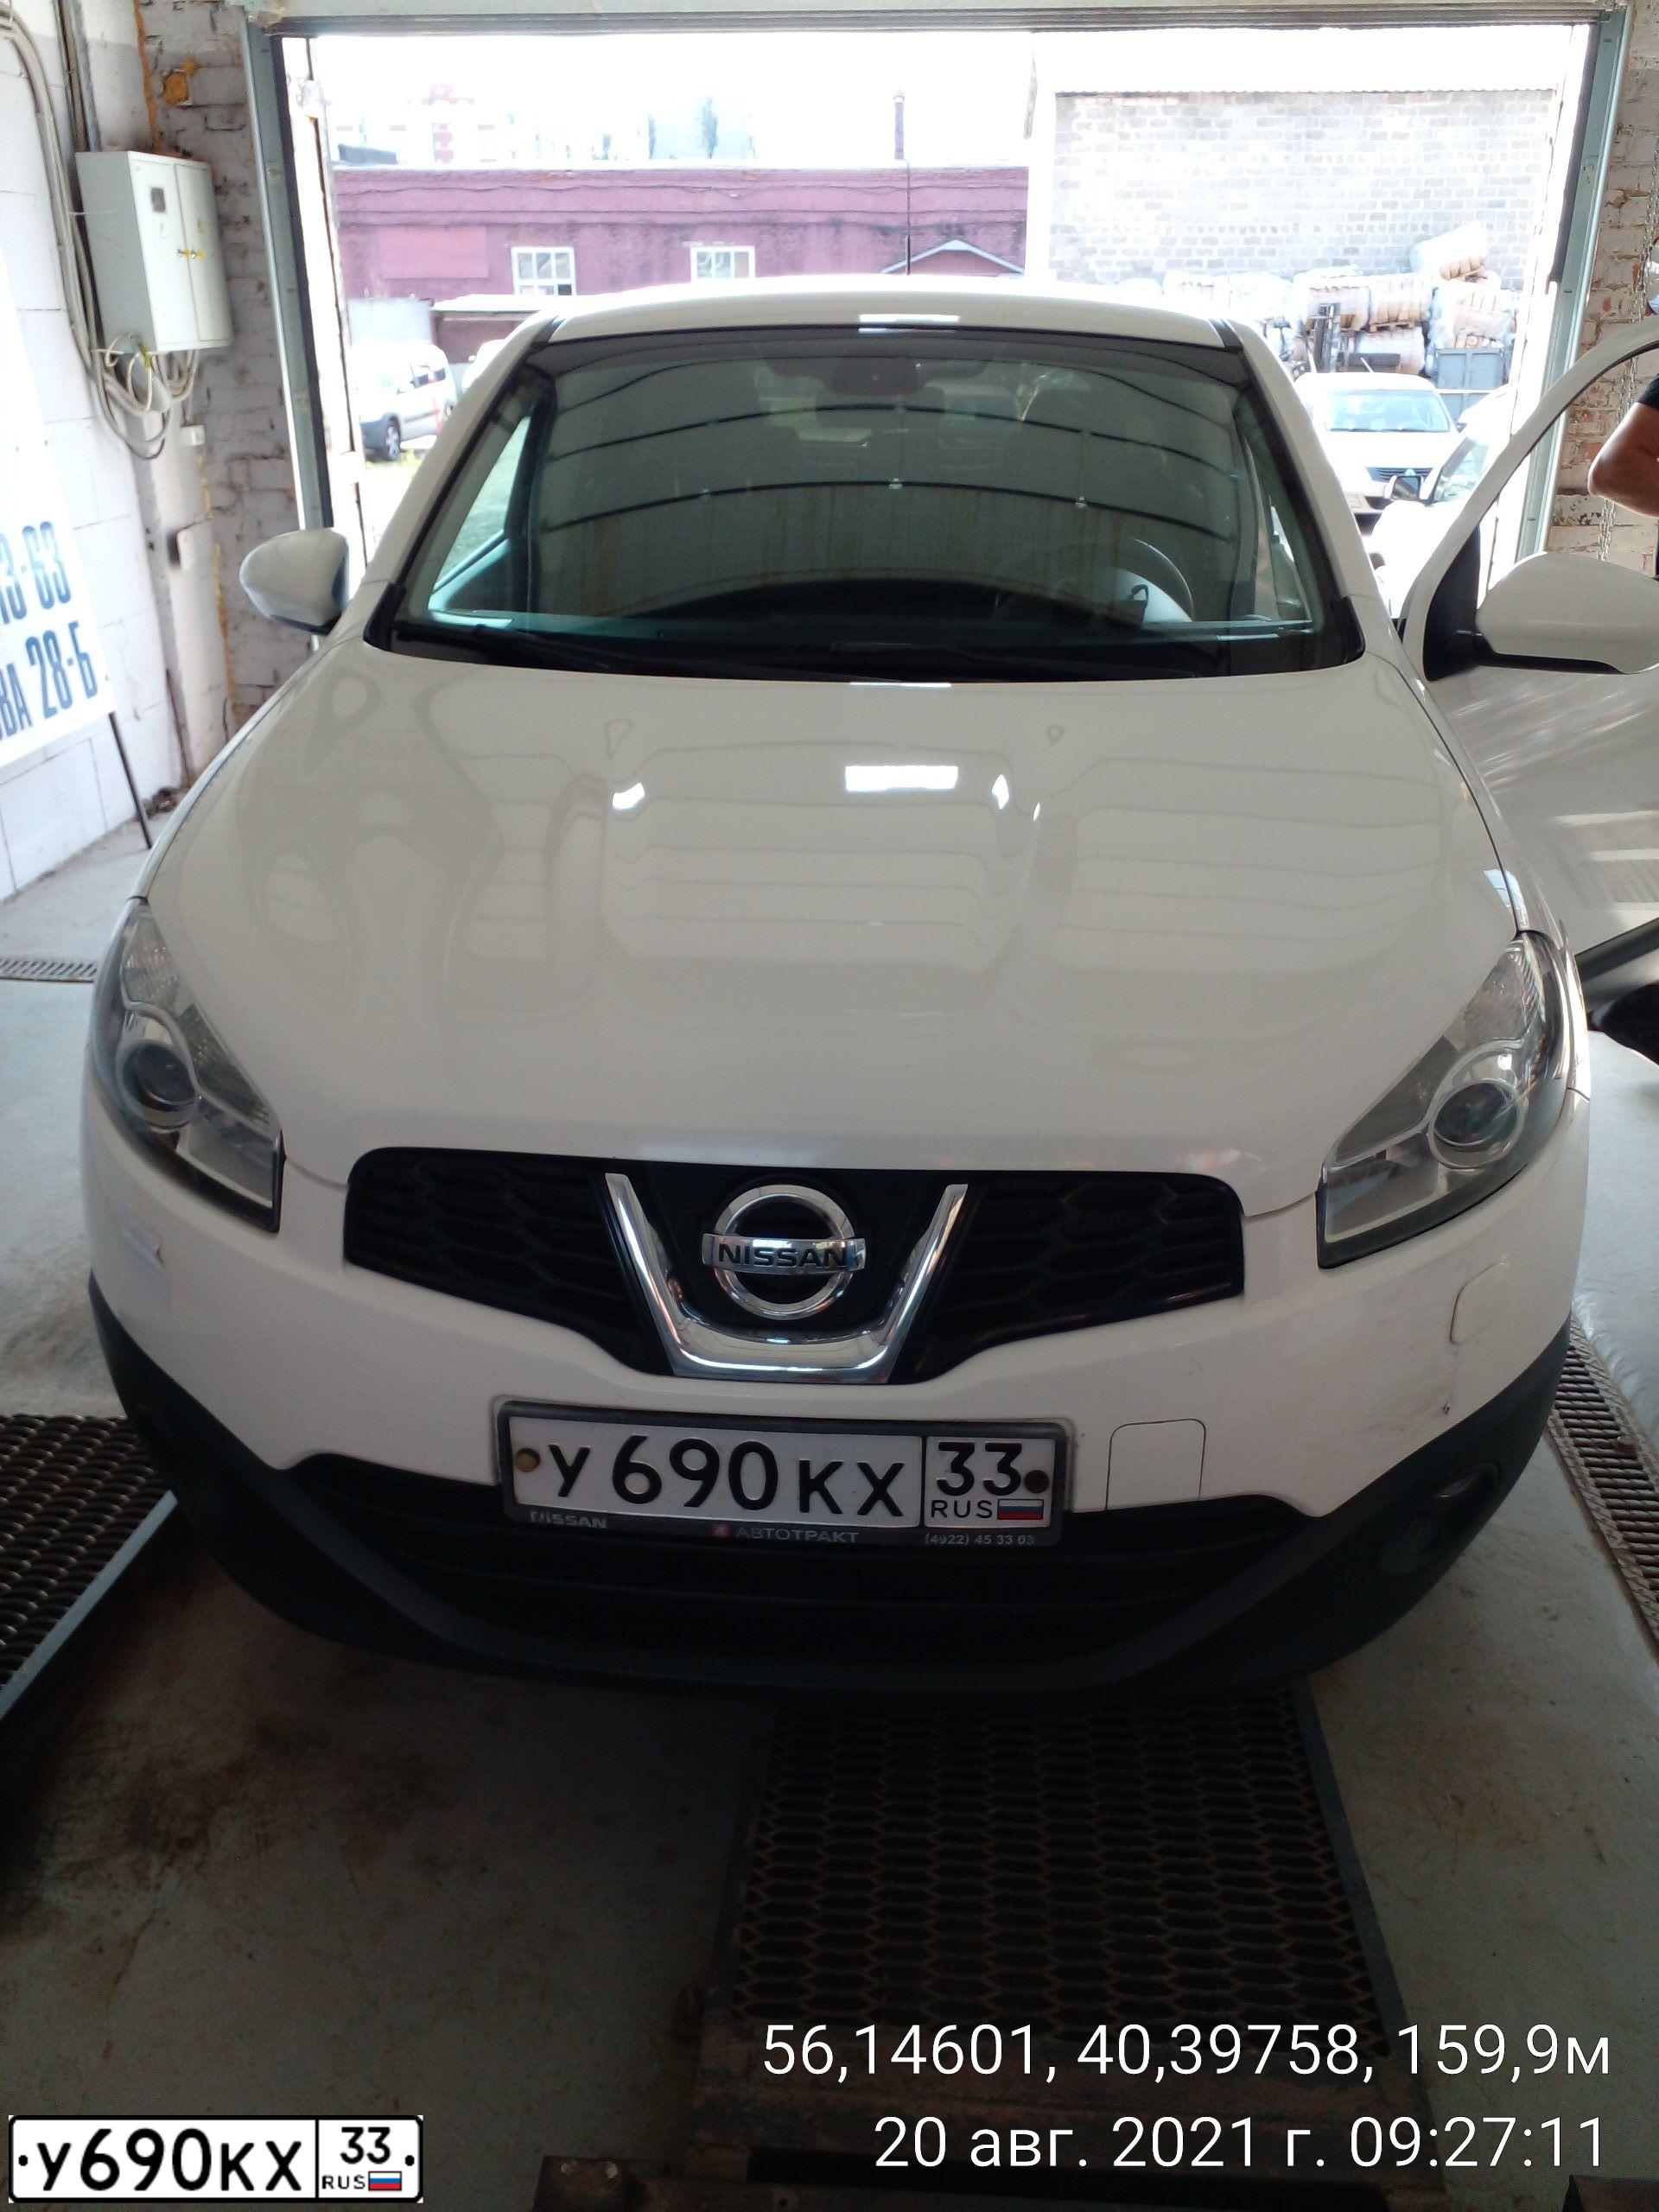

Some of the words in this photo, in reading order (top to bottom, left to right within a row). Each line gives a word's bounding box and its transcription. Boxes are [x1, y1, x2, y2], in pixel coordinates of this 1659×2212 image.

[719, 1243, 848, 1268] NISSAN
[937, 1441, 1022, 1497] 33
[931, 1499, 993, 1519] RUS
[530, 1512, 607, 1529] NISSAN
[736, 1527, 859, 1544] АВТОТРАКТ
